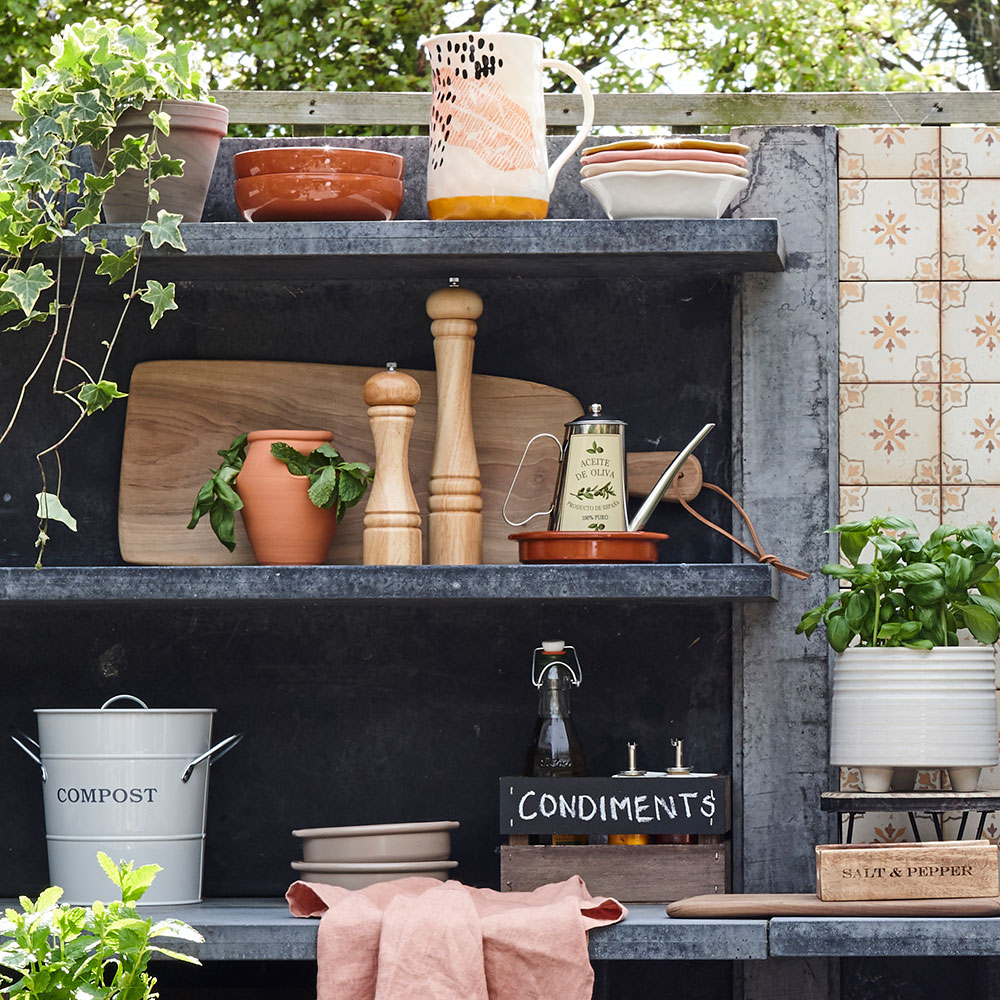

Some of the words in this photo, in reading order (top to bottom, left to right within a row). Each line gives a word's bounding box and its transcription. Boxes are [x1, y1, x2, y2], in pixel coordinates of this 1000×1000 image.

[581, 458, 610, 468] ACEITE
[575, 470, 588, 481] DE
[590, 469, 615, 478] OLIVA
[566, 501, 594, 511] PRODUCTO
[602, 500, 620, 511] ESPAÑA
[57, 788, 158, 803] COMPOST
[518, 790, 716, 823] CONDIMENTS
[842, 868, 886, 879] SALT
[889, 867, 903, 878] &
[907, 865, 973, 877] PEPPER
